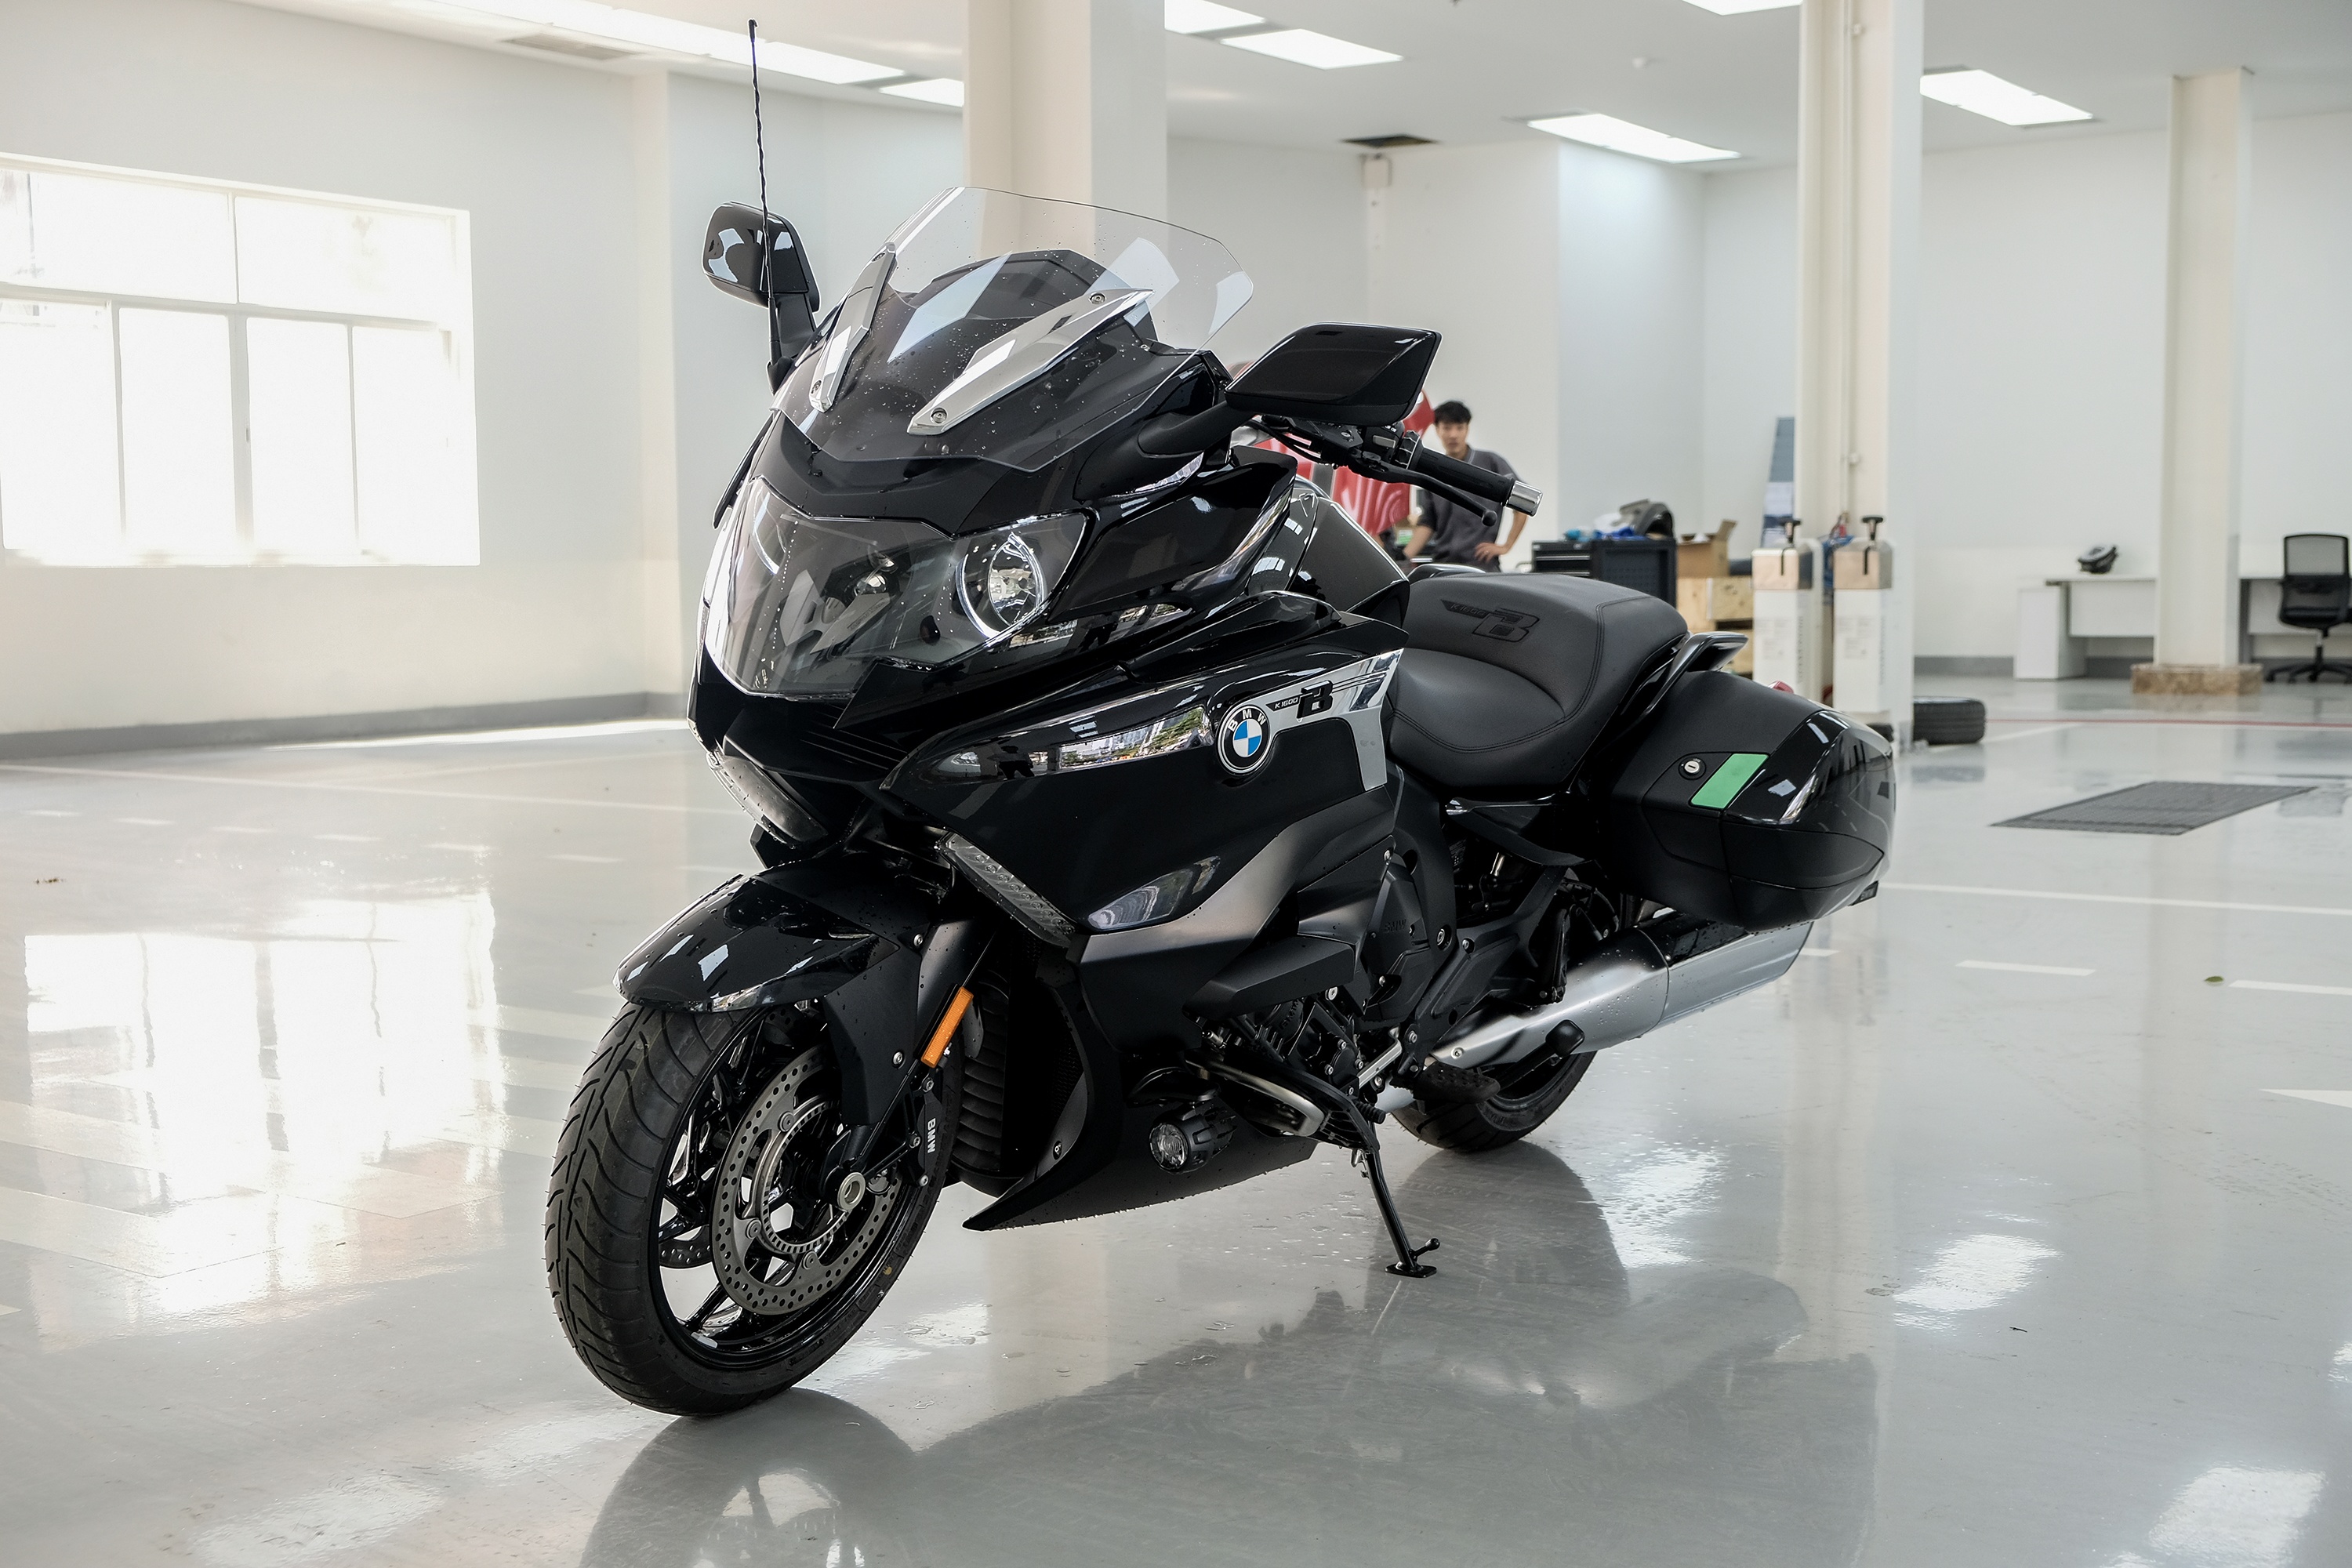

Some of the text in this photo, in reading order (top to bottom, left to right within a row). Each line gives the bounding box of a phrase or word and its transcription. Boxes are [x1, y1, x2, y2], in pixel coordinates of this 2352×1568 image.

[1472, 607, 1541, 642] B
[1281, 697, 1299, 707] 1600
[1297, 680, 1334, 719] B
[1228, 708, 1267, 732] BMW
[1383, 918, 1406, 934] BMW
[927, 1117, 936, 1154] BMW
